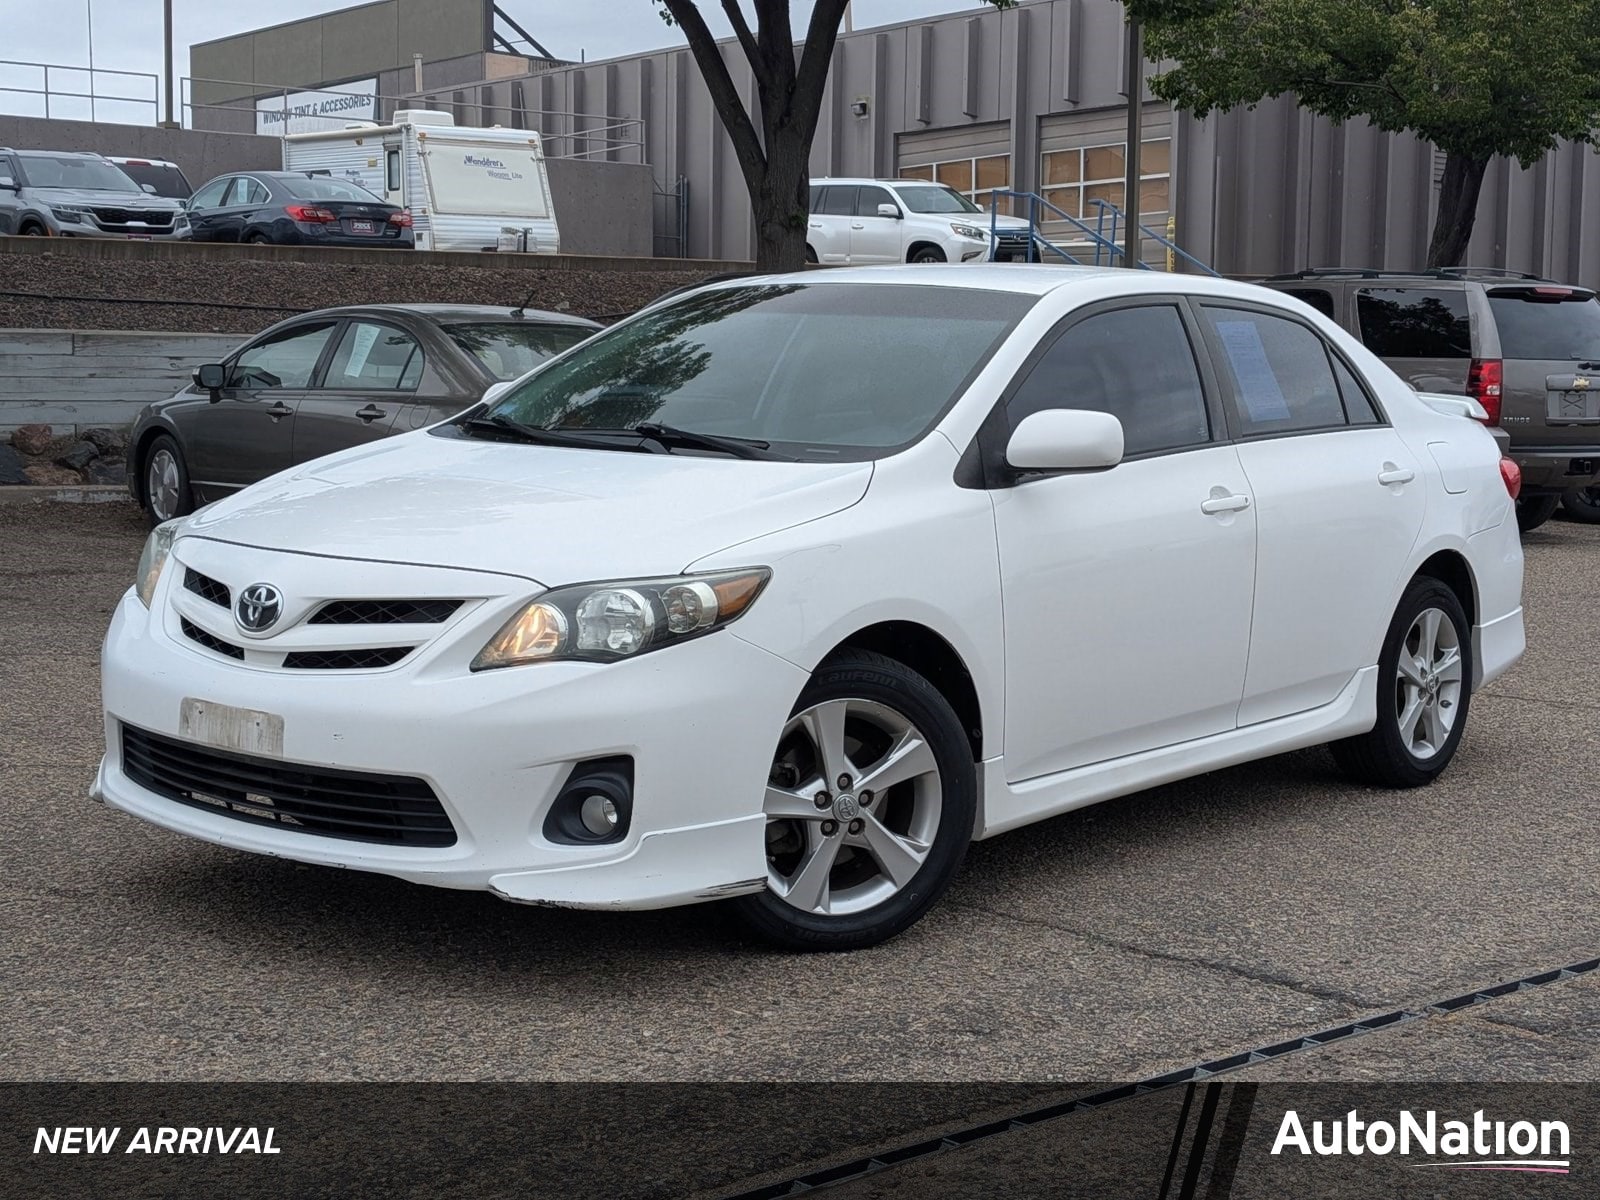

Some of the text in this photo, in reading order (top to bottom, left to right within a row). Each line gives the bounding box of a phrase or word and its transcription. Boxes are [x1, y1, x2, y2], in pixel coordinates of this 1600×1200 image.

[263, 93, 372, 125] WINDOW TINT & ACCESSORIES
[1503, 416, 1531, 424] TAHOE
